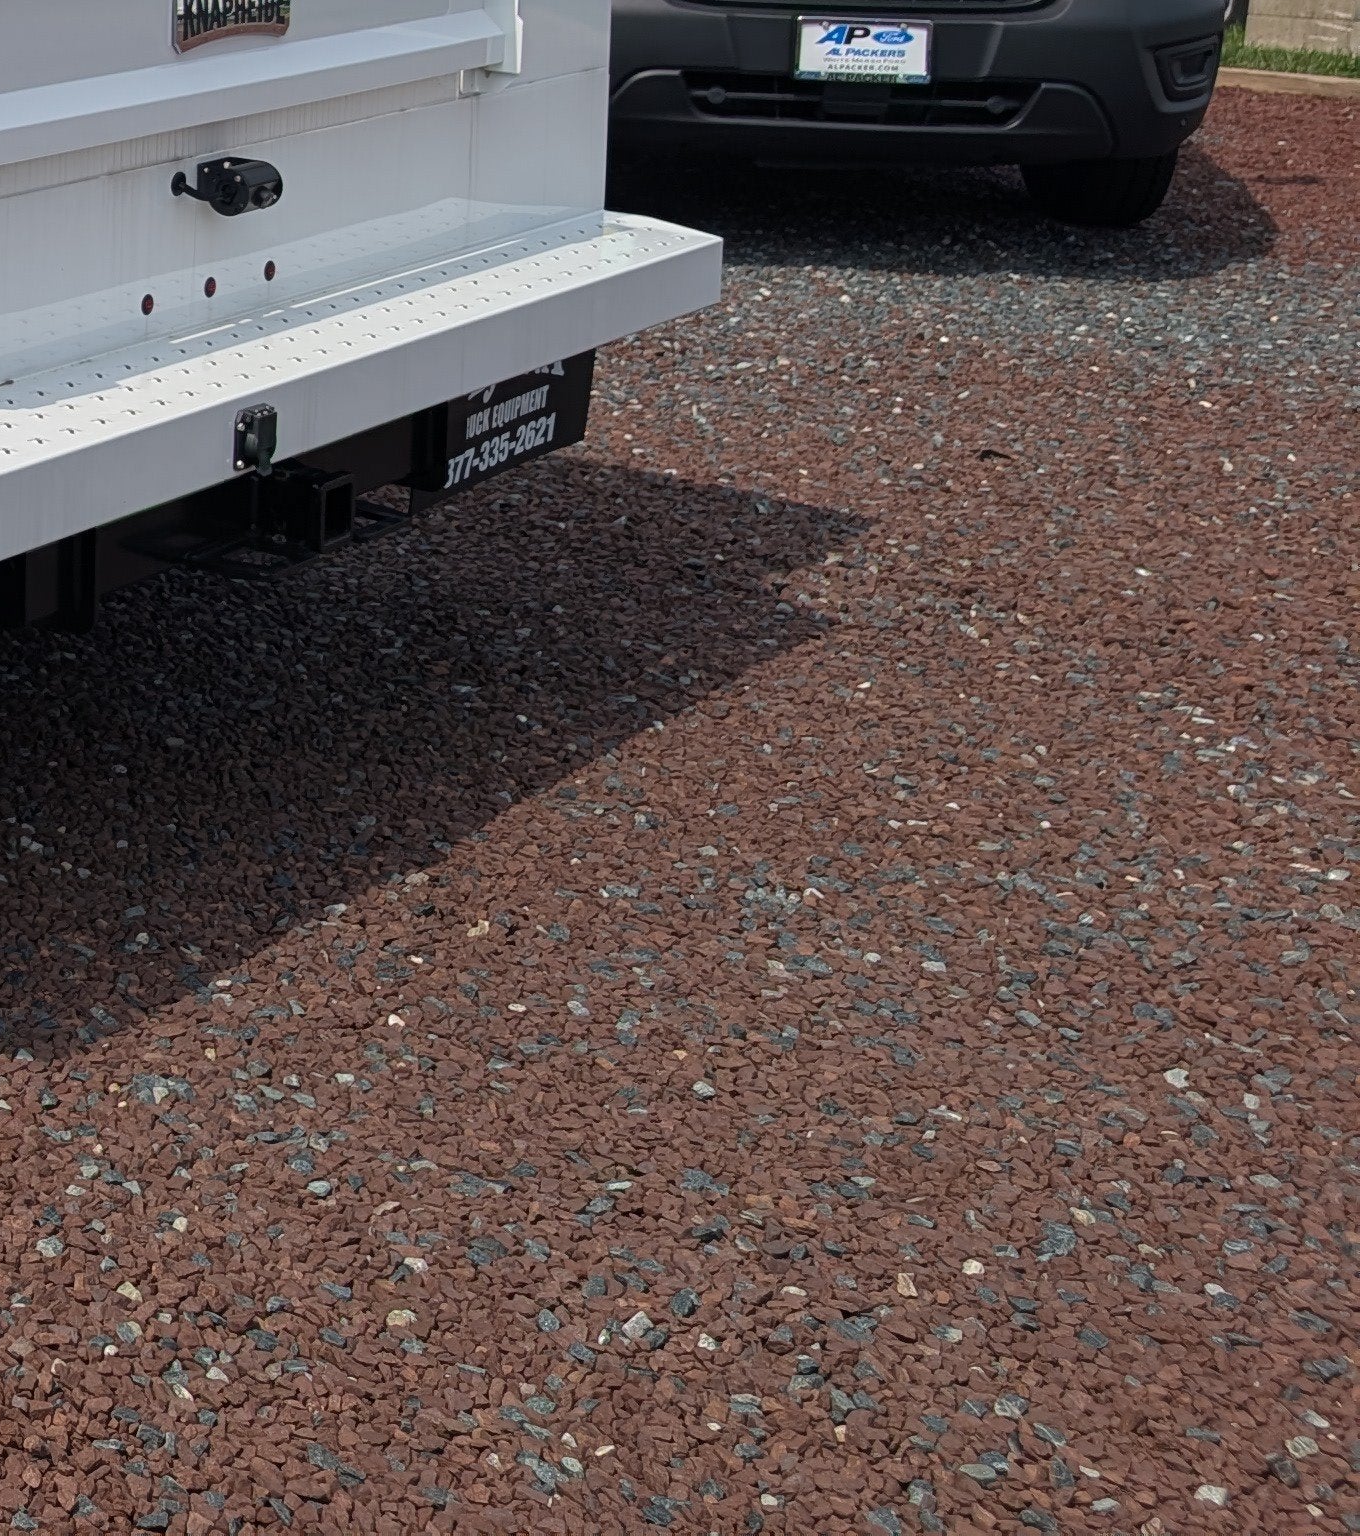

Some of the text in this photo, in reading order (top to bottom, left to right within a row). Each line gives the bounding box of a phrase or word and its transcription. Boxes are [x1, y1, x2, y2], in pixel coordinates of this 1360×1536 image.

[815, 24, 871, 45] AP
[845, 48, 906, 58] PACKERS
[491, 384, 550, 429] EQUIPMENT
